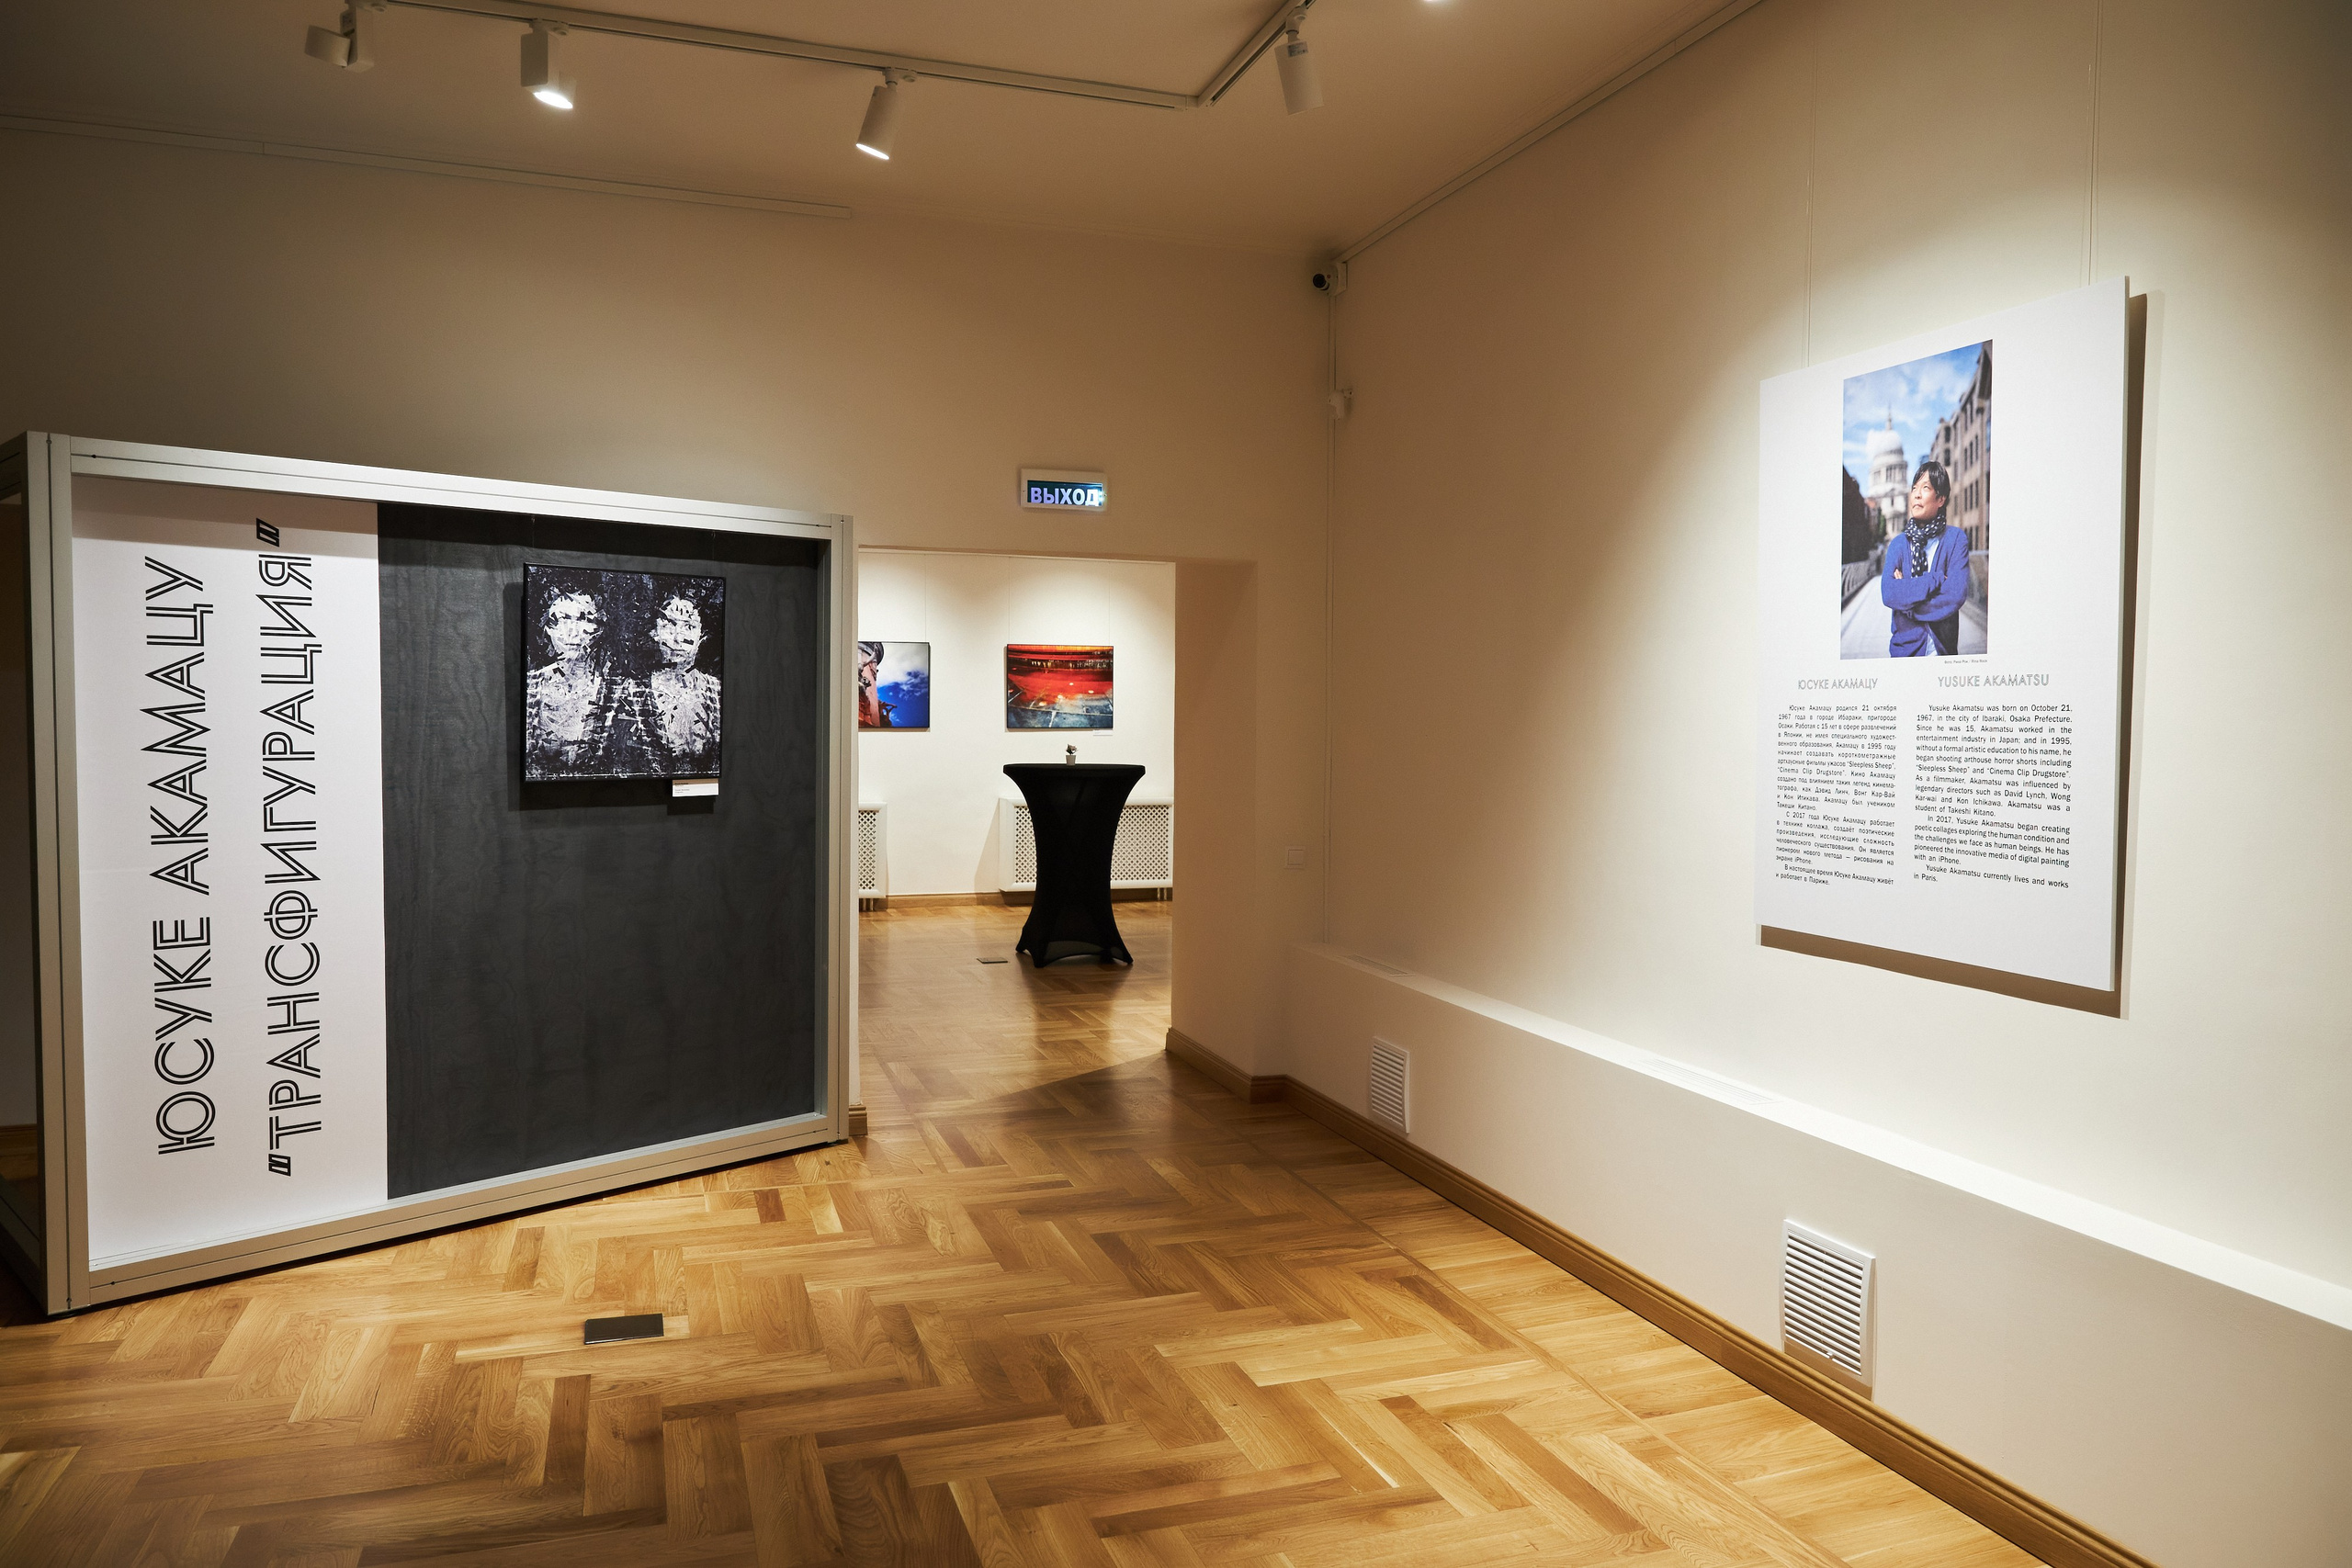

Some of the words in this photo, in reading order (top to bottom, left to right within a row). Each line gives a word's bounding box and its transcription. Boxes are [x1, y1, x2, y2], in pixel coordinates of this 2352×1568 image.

[1030, 487, 1100, 507] ВЫХОД
[1798, 679, 1829, 690] ЮСУКЕ
[1831, 678, 1878, 690] АКАМАЦУ
[1938, 675, 1980, 687] YUSUKE
[1984, 673, 2050, 687] AKAMATSU
[2030, 704, 2058, 712] October
[141, 556, 214, 896] АКАМАЦУ
[1958, 715, 1970, 723] city
[2009, 715, 2030, 723] Osaka
[1916, 724, 1933, 732] Since
[1980, 725, 2014, 733] Akamatsu
[2018, 726, 2043, 734] worked
[2060, 726, 2073, 734] the
[1916, 734, 1959, 742] entertainment
[1961, 735, 1987, 744] industry
[1989, 735, 1996, 743] in
[1943, 744, 1964, 752] formal
[1964, 745, 1986, 753] artistic
[1986, 746, 2019, 754] education
[2028, 747, 2039, 755] his
[2063, 748, 2072, 756] he
[1916, 754, 1934, 762] began
[1936, 754, 1962, 764] shooting
[1963, 756, 1992, 764] arthouse
[1994, 756, 2014, 765] horror
[2016, 757, 2038, 766] shorts
[2040, 758, 2072, 769] including
[2017, 768, 2030, 778] Clip
[1969, 777, 2002, 786] Akamatsu
[2022, 780, 2059, 789] influenced
[2063, 782, 2072, 790] by
[1915, 784, 1944, 795] legendary
[1946, 786, 1973, 795] directors
[2004, 789, 2023, 798] David
[2050, 792, 2072, 803] Wong
[1915, 794, 1937, 803] Kar-wai
[1956, 796, 1969, 805] Kon
[2007, 800, 2042, 810] Akamatsu
[1948, 806, 1972, 815] Takeshi
[1956, 817, 1979, 826] Yusuke
[1981, 819, 2015, 829] Akamatsu
[2017, 822, 2039, 832] began
[2041, 825, 2071, 836] creating
[1914, 824, 1933, 832] poetic
[1932, 826, 1958, 835] collages
[1958, 828, 1987, 838] exploring
[1987, 829, 1998, 839] the
[1999, 830, 2023, 840] human
[2023, 834, 2055, 843] condition
[2055, 837, 2070, 845] and
[1914, 833, 1925, 841] the
[1925, 834, 1958, 845] challenges
[1969, 838, 1984, 847] face
[1994, 840, 2018, 851] human
[2044, 846, 2055, 854] He
[2056, 847, 2070, 856] has
[1913, 852, 1927, 861] with
[1914, 843, 1944, 853] pioneered
[1944, 846, 1955, 854] the
[1955, 847, 1987, 858] innovative
[1988, 852, 2009, 860] media
[2009, 852, 2018, 861] of
[2018, 854, 2040, 864] digital
[2041, 857, 2070, 869] painting
[1926, 863, 1948, 874] Yusuke
[1949, 866, 1982, 878] Akamatsu
[1983, 872, 2012, 883] currently
[2014, 874, 2030, 884] lives
[2047, 880, 2069, 889] works
[153, 916, 216, 1156] ЮСУКЕ
